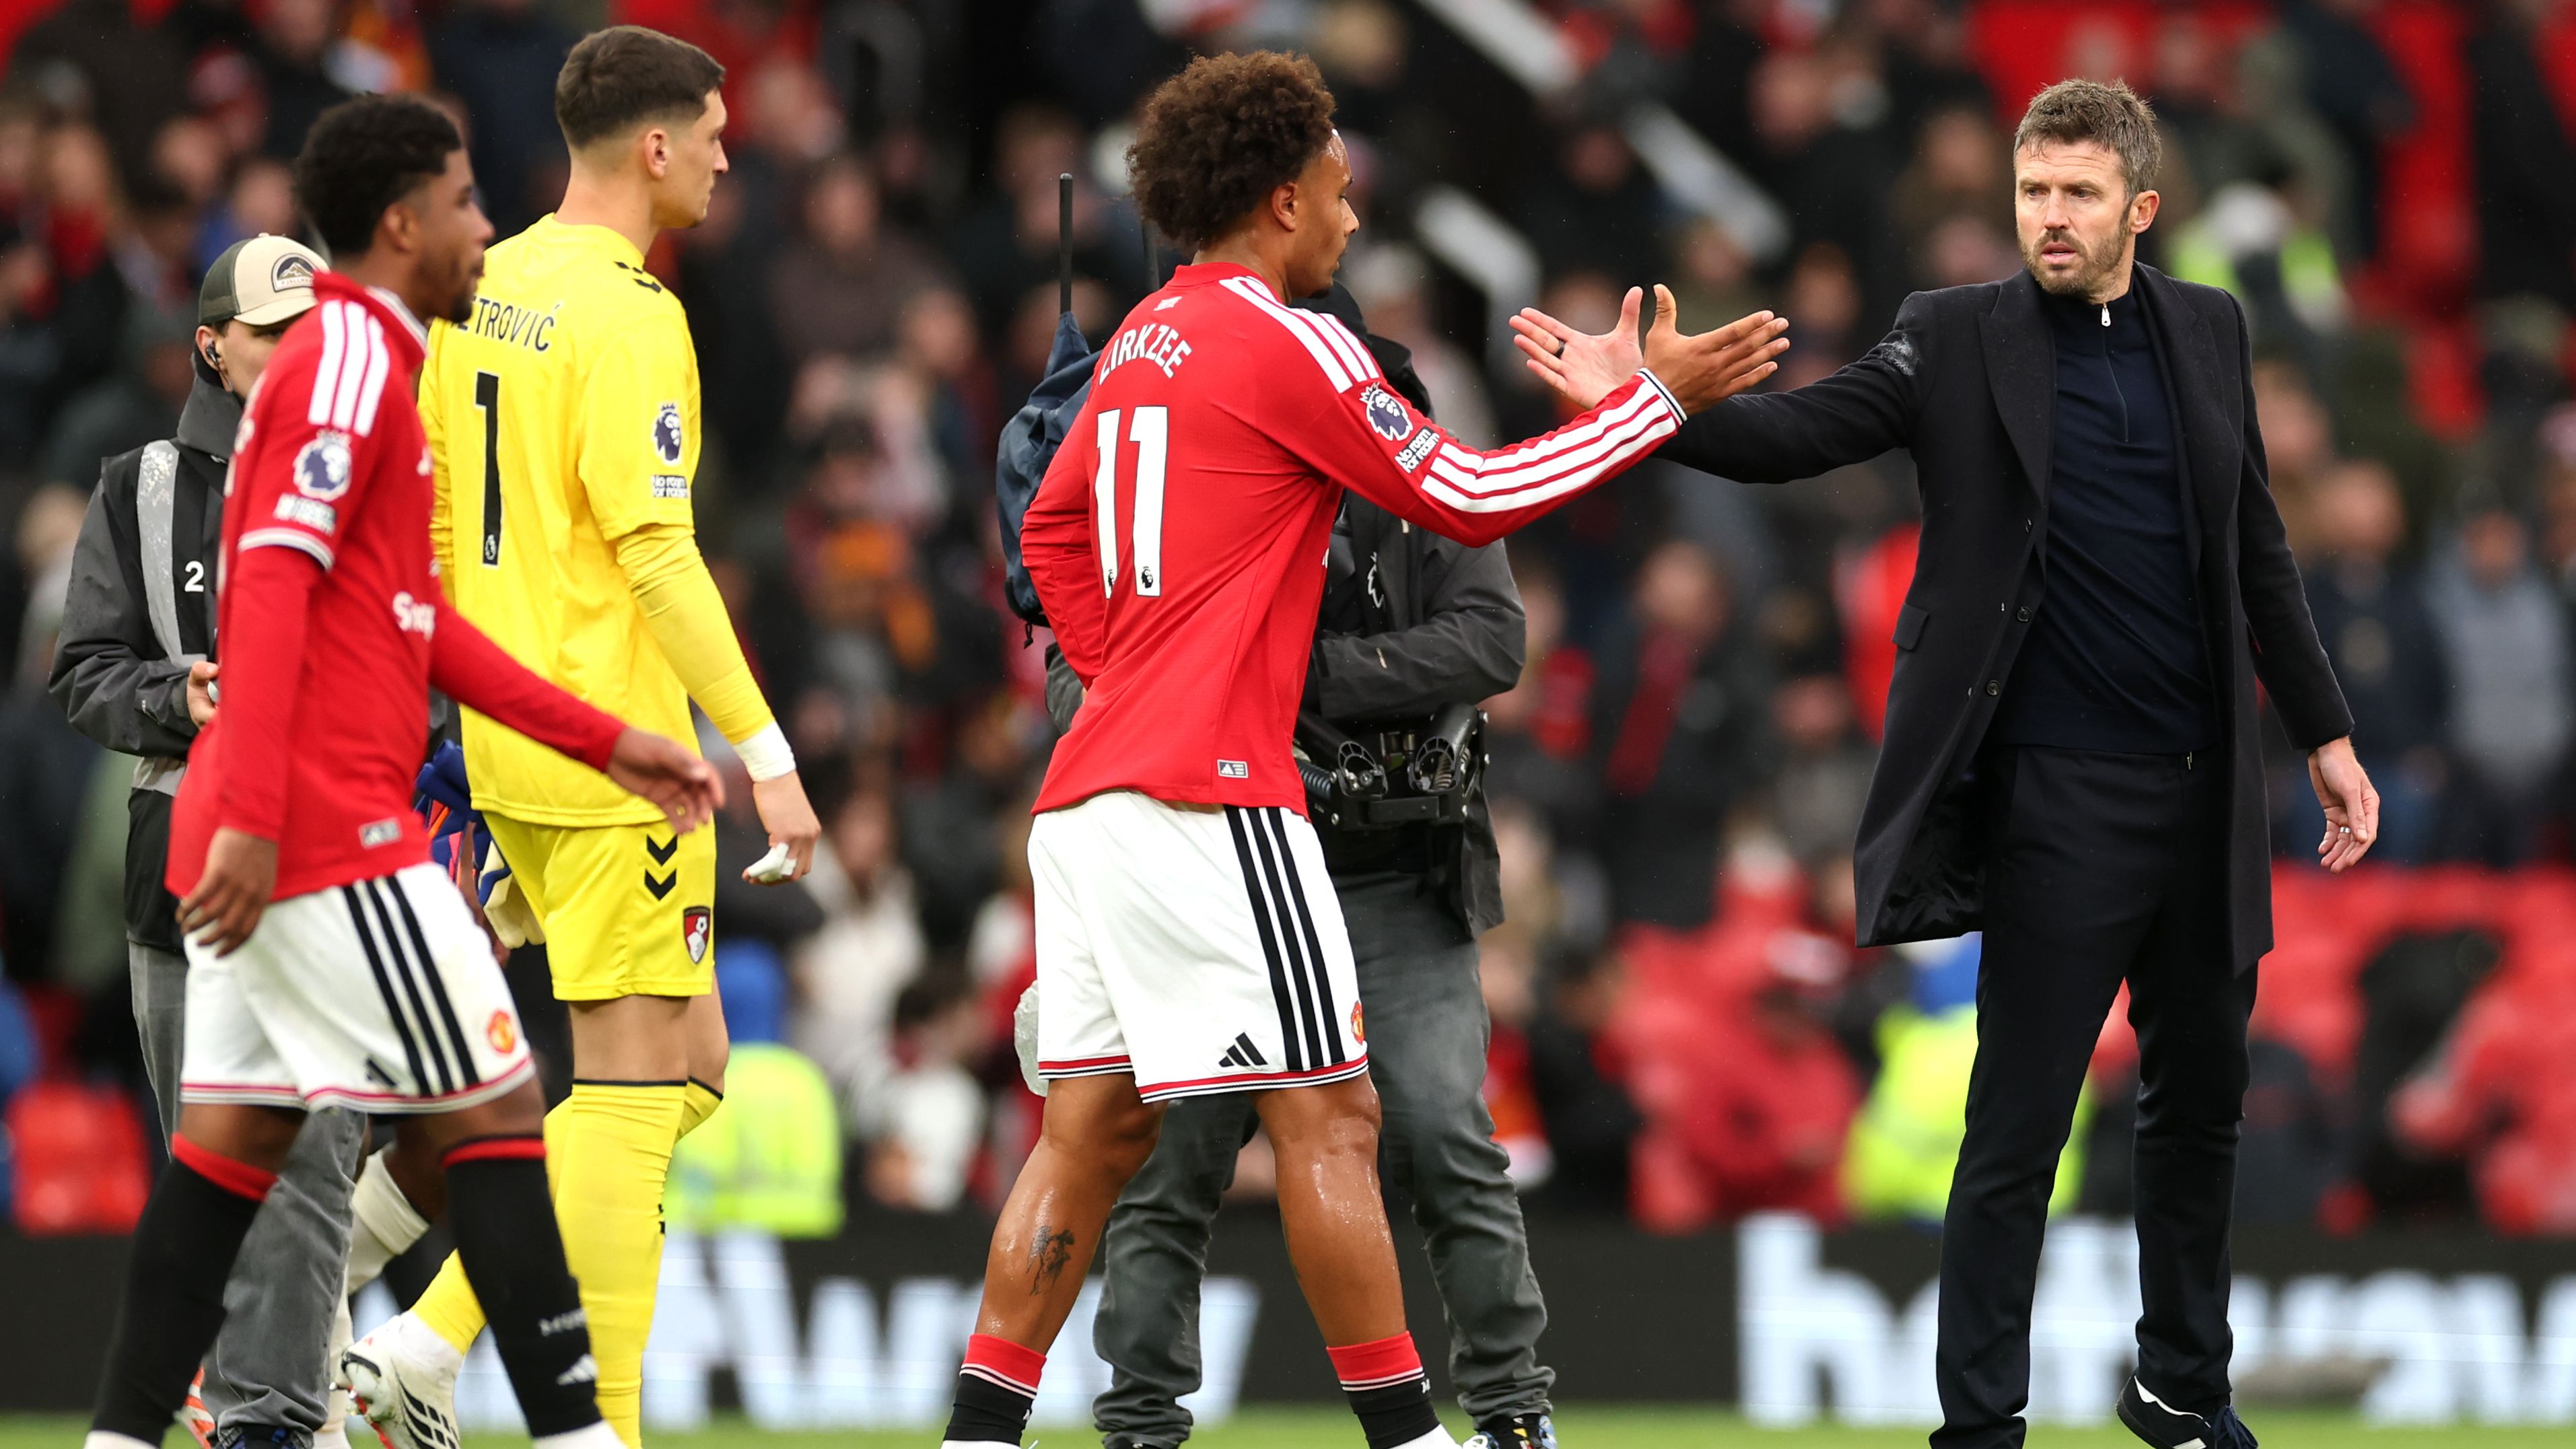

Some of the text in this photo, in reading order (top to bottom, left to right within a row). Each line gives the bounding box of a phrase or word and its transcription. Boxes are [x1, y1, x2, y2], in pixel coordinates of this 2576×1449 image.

[450, 295, 560, 352] TROVIĆ
[1099, 322, 1193, 386] ZIRKZEE
[475, 371, 502, 566] 1
[1394, 427, 1432, 466] No room
[1402, 432, 1440, 474] for racism
[1094, 404, 1169, 600] 11
[184, 559, 205, 593] 2
